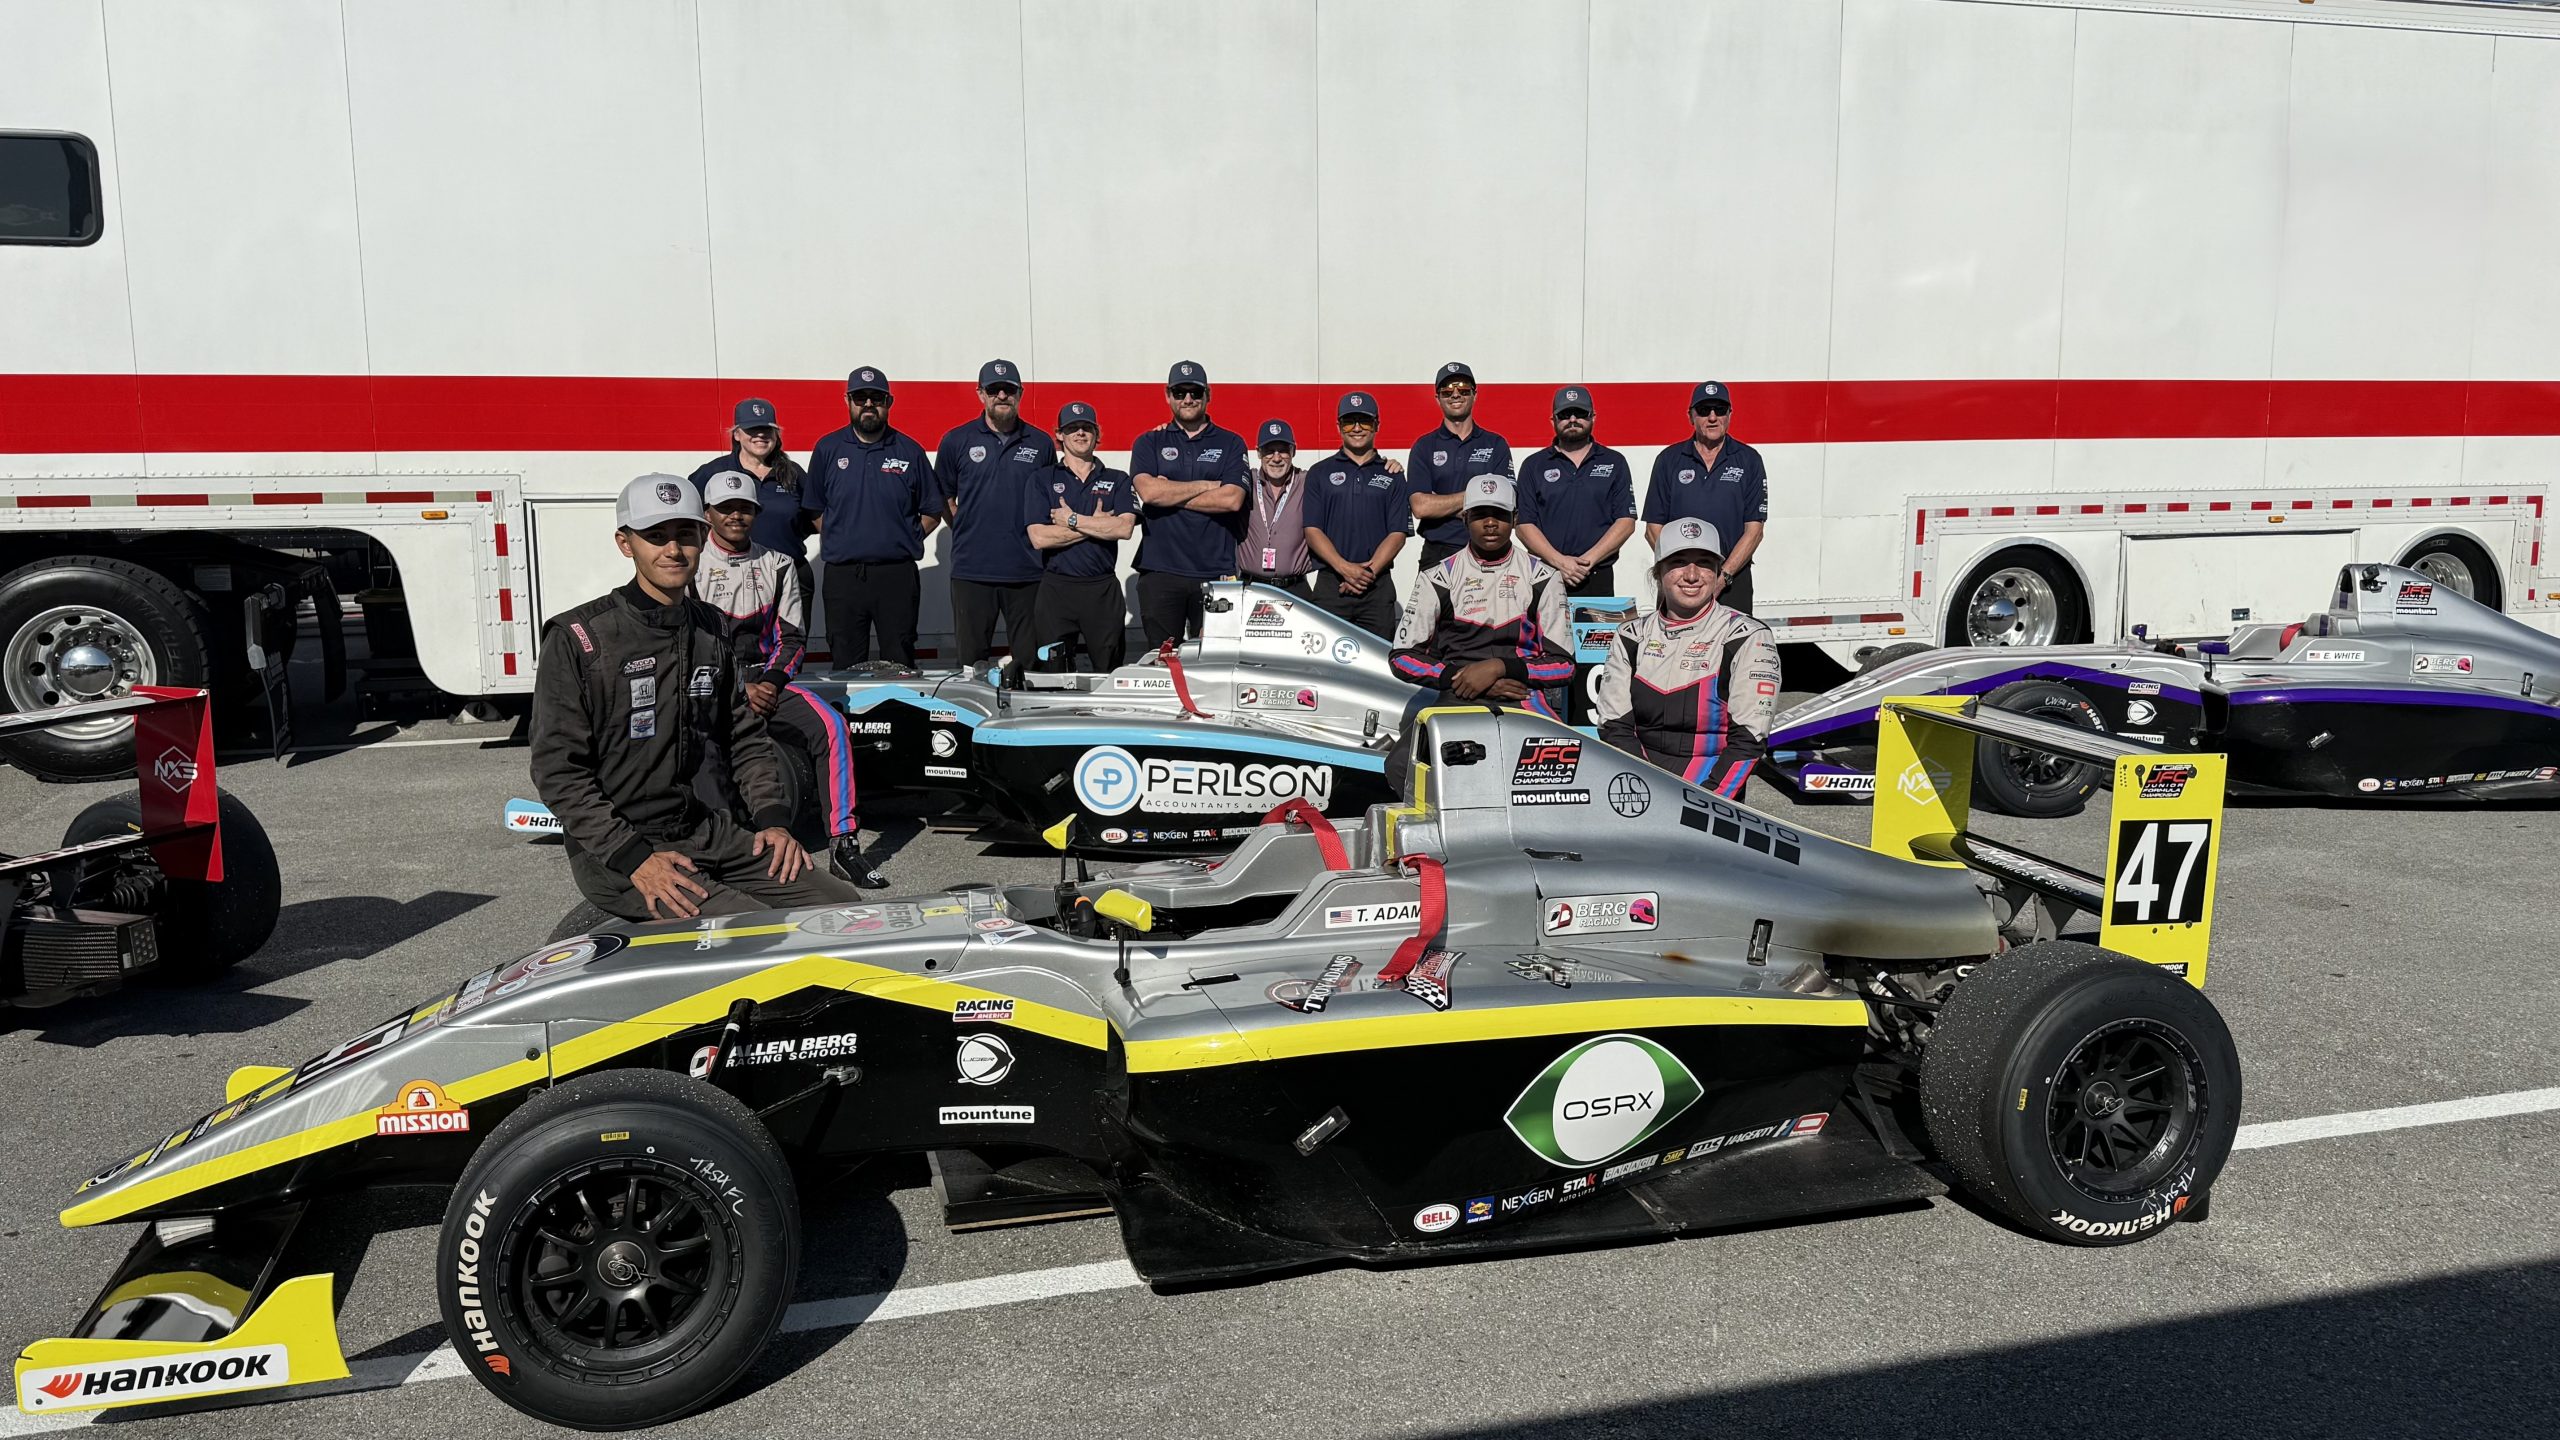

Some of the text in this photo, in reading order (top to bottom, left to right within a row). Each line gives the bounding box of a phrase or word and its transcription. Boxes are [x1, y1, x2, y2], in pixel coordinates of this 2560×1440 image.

[2323, 652, 2361, 660] E. WHITE
[1133, 680, 1171, 688] T. WADE
[1260, 689, 1295, 698] BERG
[865, 722, 891, 730] BERG
[1525, 738, 1581, 746] LIGIER
[1520, 747, 1580, 764] JFC
[154, 759, 198, 779] NXS
[926, 768, 966, 776] mountune
[1147, 764, 1327, 797] PERLSON
[2147, 771, 2188, 782] JFC
[1146, 799, 1239, 809] ACCOUNTANTS
[1513, 792, 1589, 803] mountune
[1106, 832, 1122, 840] BELL
[1153, 830, 1188, 840] NEXGEN
[1193, 829, 1217, 838] STAK
[1975, 853, 2033, 877] GRAPHICS
[2045, 879, 2083, 896] SIGNS
[2115, 822, 2209, 921] 47
[1357, 909, 1369, 923] T.
[1576, 901, 1627, 918] BERG
[1579, 918, 1620, 927] RACING
[956, 1000, 1014, 1011] RACING
[729, 1033, 857, 1060] ALLEN BERG
[725, 1045, 858, 1068] RACING SCHOOLS
[1563, 1090, 1654, 1120] OSRX
[942, 1108, 1032, 1120] mountune
[379, 1112, 468, 1133] MISSION
[1724, 1125, 1778, 1147] HAGERTY
[1662, 1150, 1684, 1163] OMP
[1605, 1156, 1658, 1179] GARAGE
[1562, 1173, 1597, 1194] STAK
[1501, 1188, 1554, 1212] NEXGEN
[1559, 1187, 1596, 1204] AUTO LIFTS
[1469, 1202, 1492, 1214] SUNOCO
[1422, 1210, 1452, 1225] BELL
